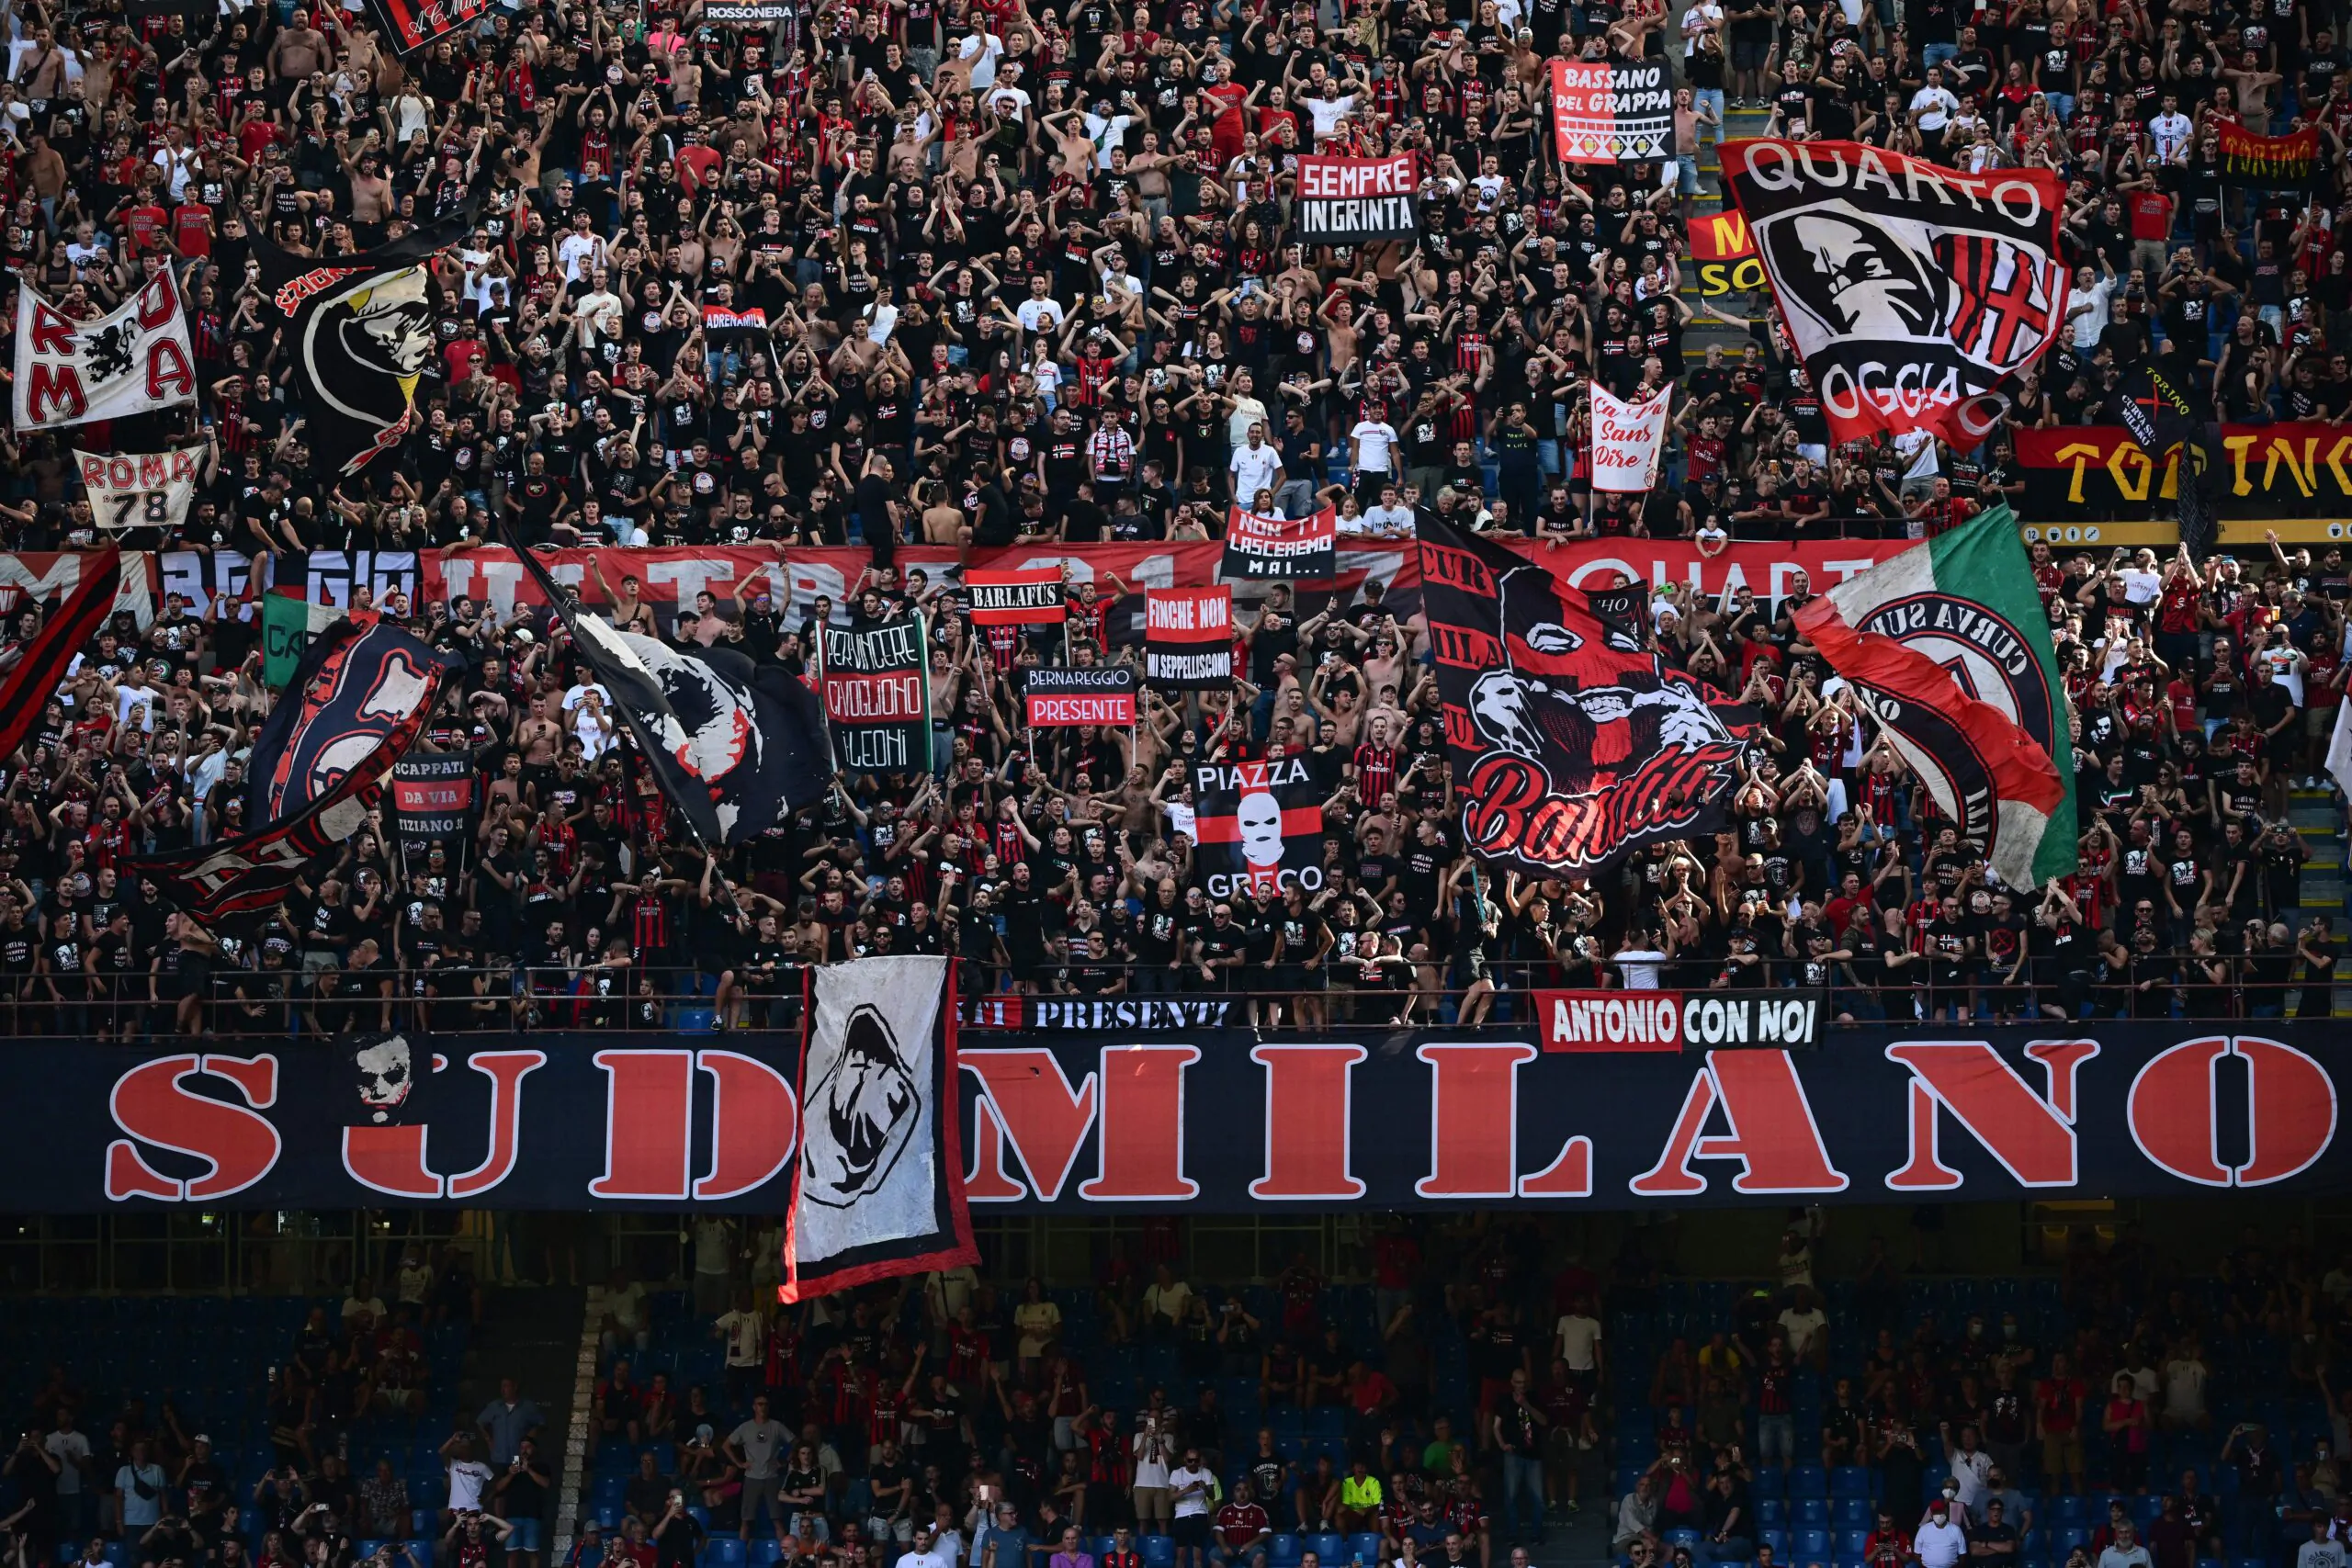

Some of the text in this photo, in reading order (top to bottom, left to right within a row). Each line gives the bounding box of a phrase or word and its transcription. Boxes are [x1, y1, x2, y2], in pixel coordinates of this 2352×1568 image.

[707, 6, 793, 19] ROSSONERA
[1565, 67, 1660, 89] BASSANO
[1556, 90, 1671, 113] DEL GRAPPA
[1304, 158, 1411, 196] SEMPRE
[1744, 142, 2041, 228] QUARTO
[1821, 361, 2011, 435] OGGIAO
[2146, 367, 2190, 415] TORINO
[2121, 394, 2146, 426] CURVA
[1600, 420, 1654, 442] Sans
[2120, 407, 2151, 446] MILANO
[1595, 446, 1642, 468] Dire
[82, 451, 199, 490] ROMA
[1238, 514, 1319, 538] NON TI
[2027, 530, 2038, 540] 12
[1229, 534, 1332, 558] LASCEREMO
[973, 581, 1057, 609] BARLAFÜS
[1148, 596, 1227, 630] FINCHÈ NON
[1029, 670, 1130, 686] BERNAREGGIO
[1148, 651, 1231, 680] MI SEPPELLISCONO
[1035, 699, 1127, 721] PRESENTE
[395, 761, 465, 776] SCAPPATI
[1197, 759, 1310, 792] PIAZZA
[1366, 765, 1390, 773] Emirates
[404, 790, 457, 805] DA VIA
[399, 818, 454, 832] TIZIANO
[1035, 1000, 1231, 1030] PRESENTI
[1553, 998, 1816, 1043] ANTONIO CON NOI
[956, 1035, 2338, 1203] MILANO
